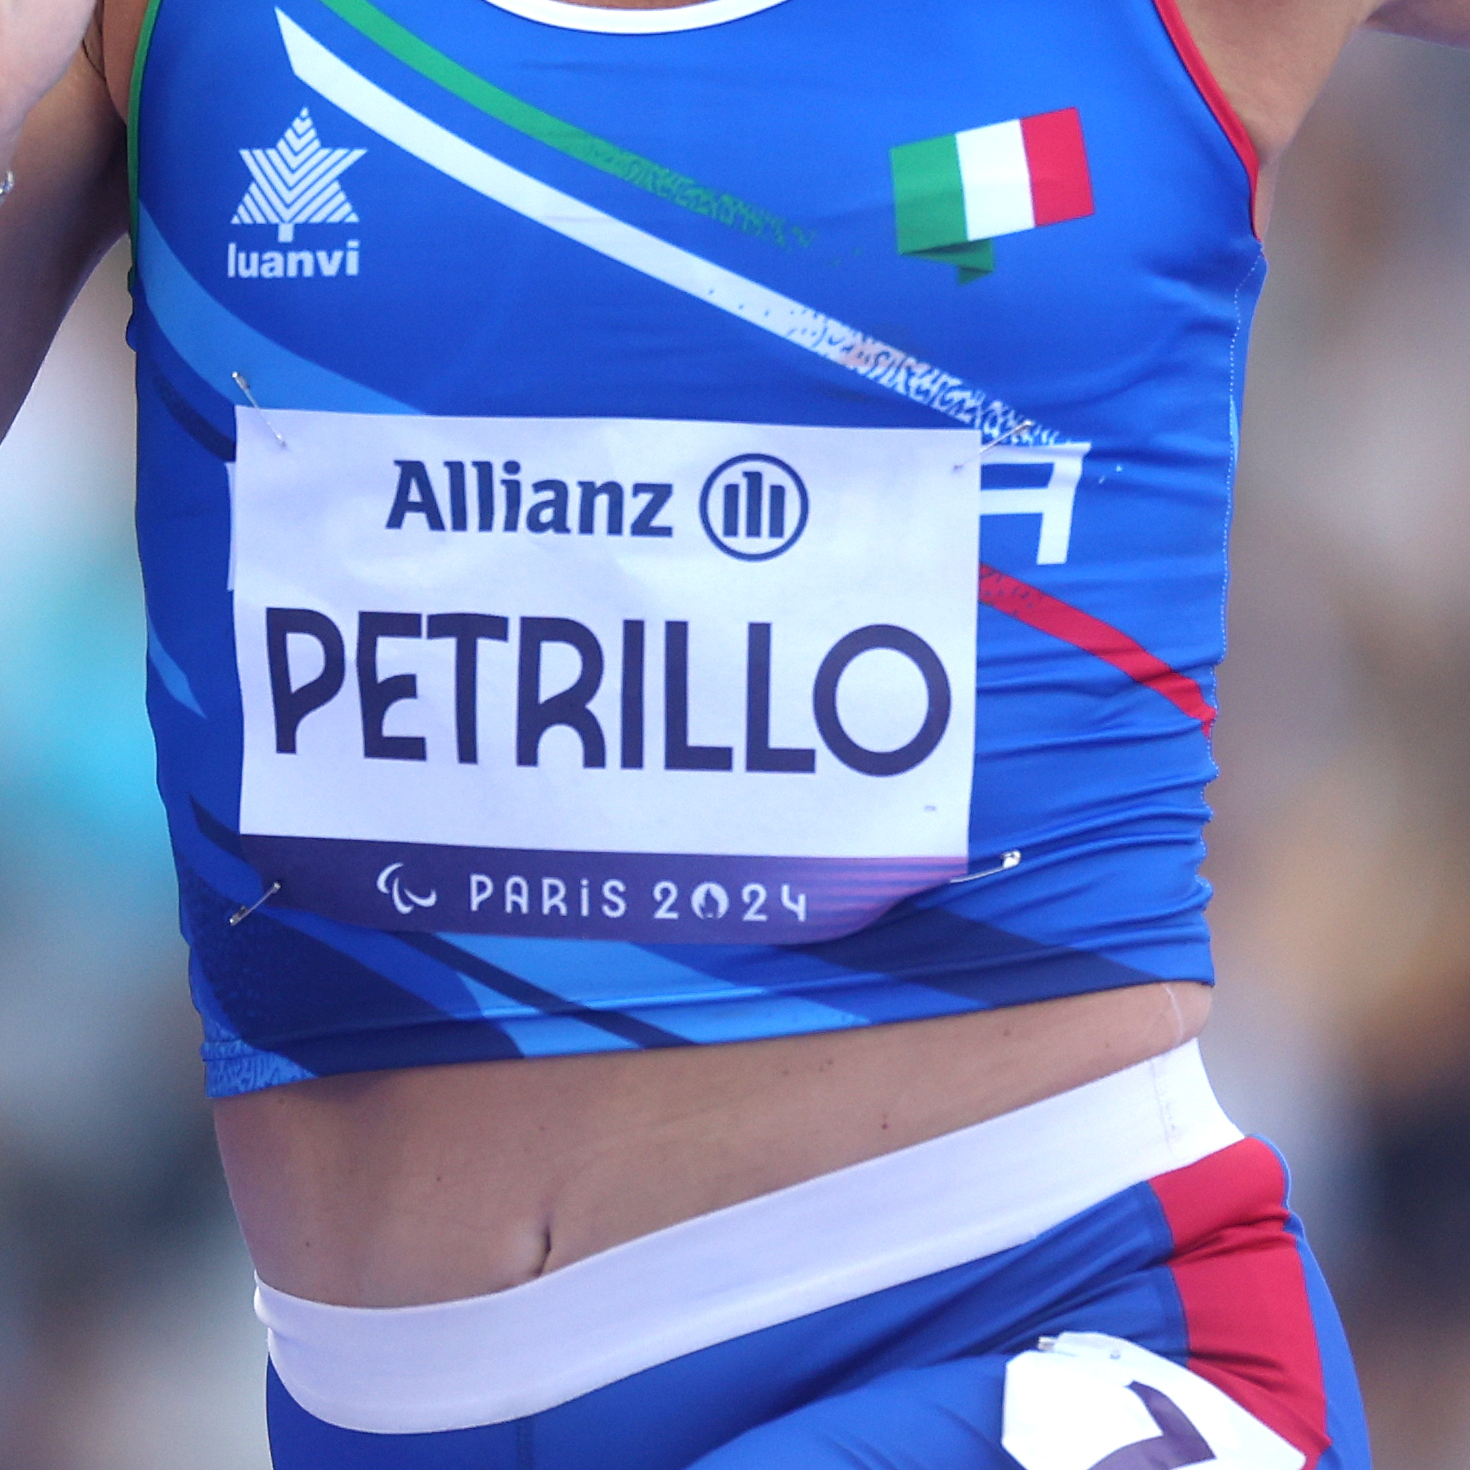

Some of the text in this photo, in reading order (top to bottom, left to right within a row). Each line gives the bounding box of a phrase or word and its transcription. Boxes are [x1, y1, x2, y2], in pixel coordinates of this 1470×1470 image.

[228, 239, 360, 278] luanvi
[386, 459, 674, 538] Allianz
[265, 606, 952, 778] PETRILLO
[653, 880, 807, 923] 2024
